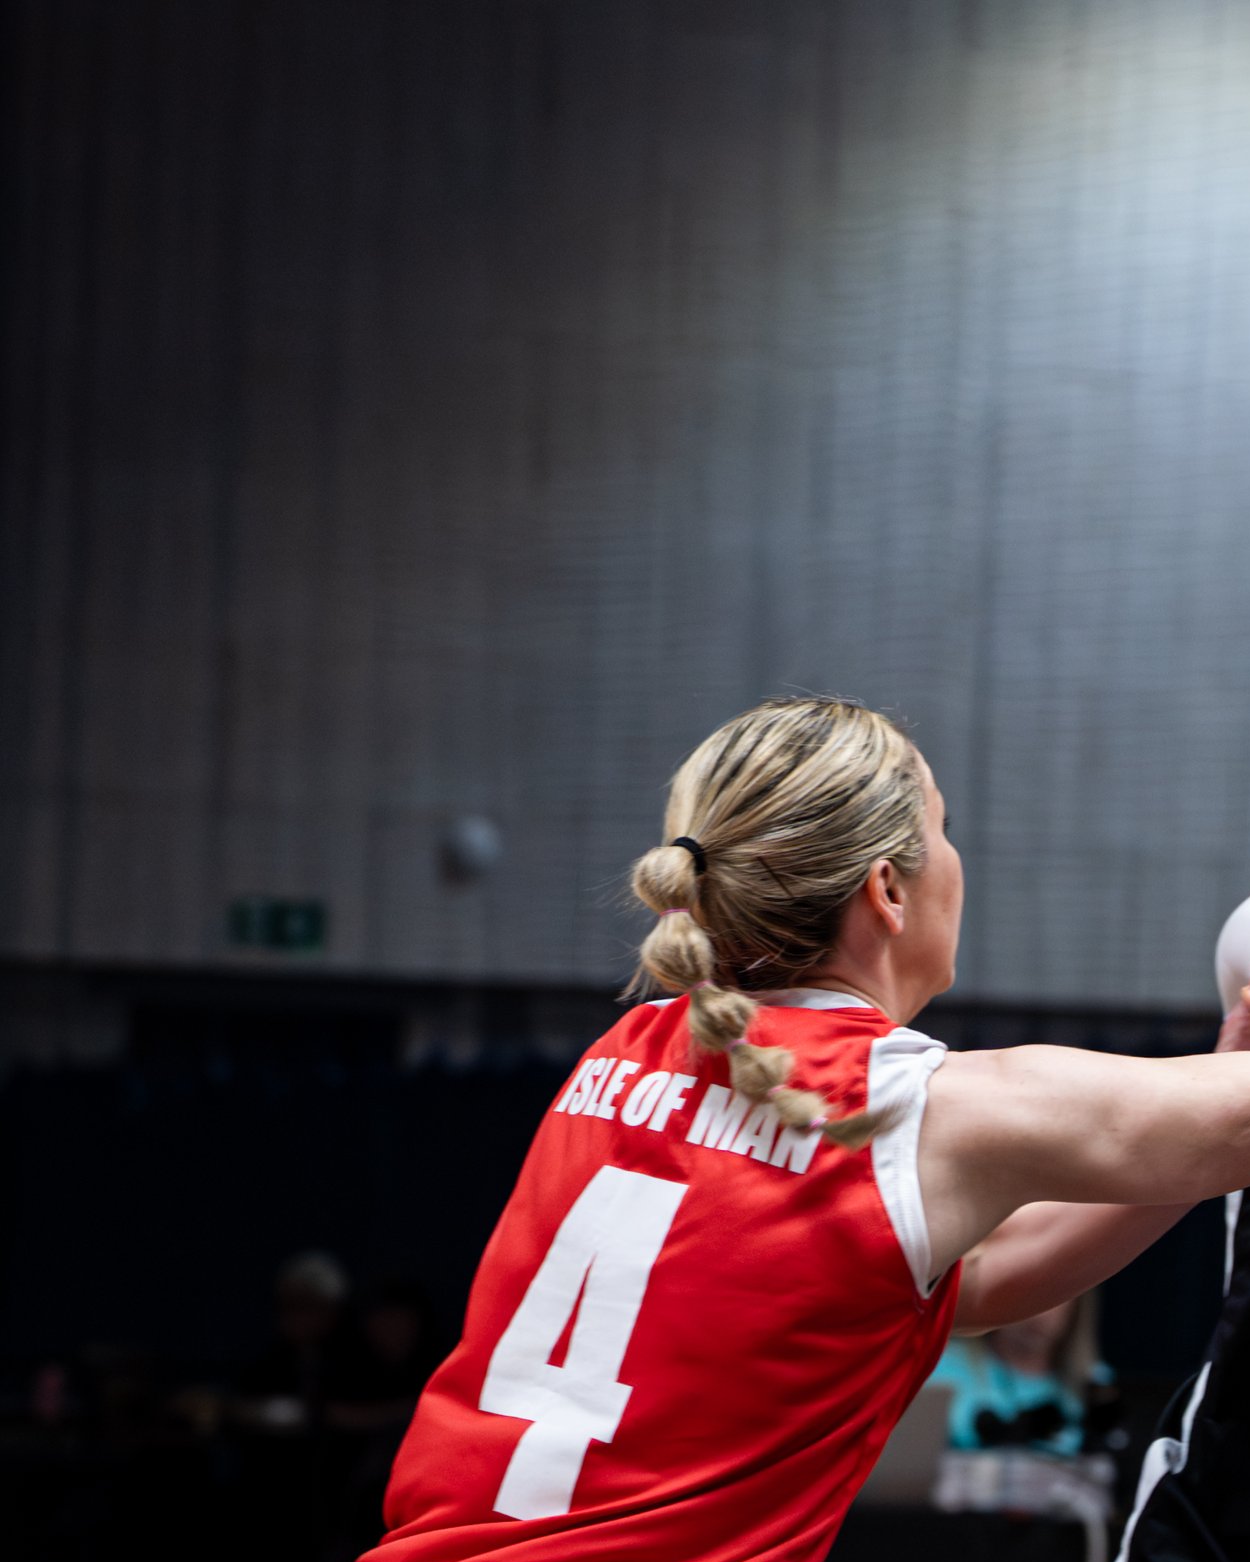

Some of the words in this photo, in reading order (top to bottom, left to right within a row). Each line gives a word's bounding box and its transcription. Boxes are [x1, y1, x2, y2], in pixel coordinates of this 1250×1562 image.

[554, 1057, 638, 1122] ISLE
[620, 1070, 698, 1133] OF
[478, 1164, 689, 1521] 4
